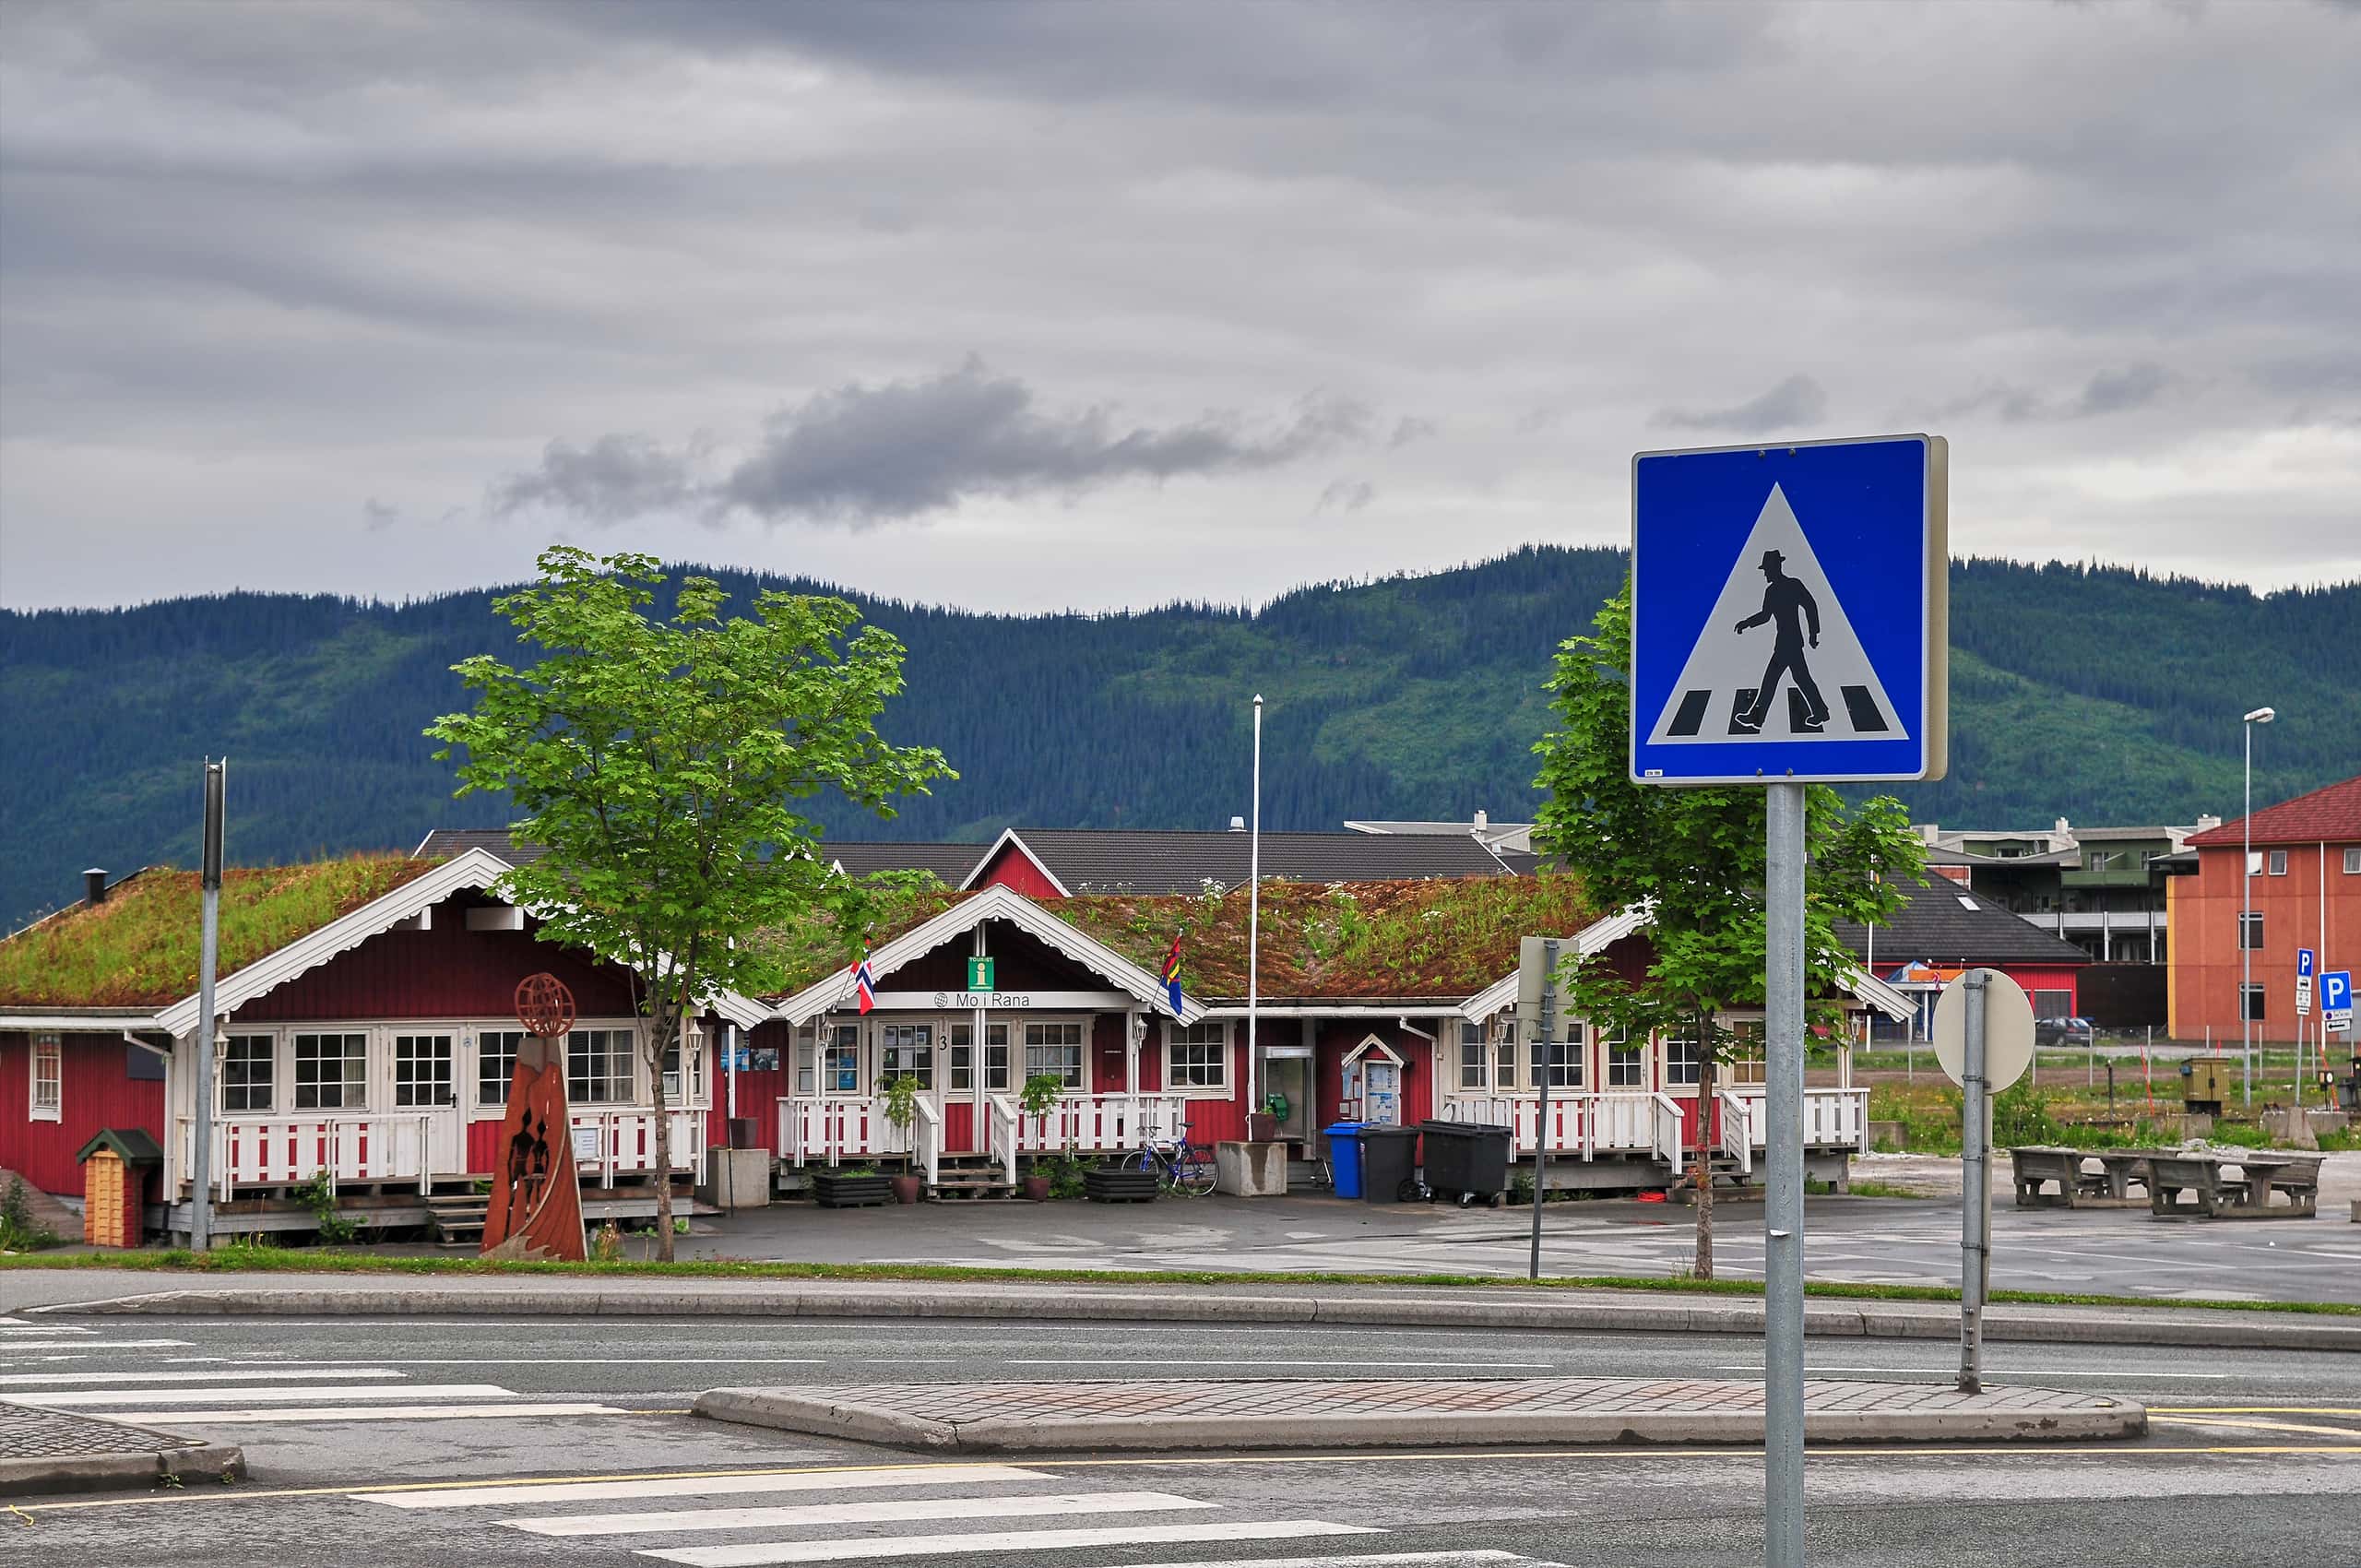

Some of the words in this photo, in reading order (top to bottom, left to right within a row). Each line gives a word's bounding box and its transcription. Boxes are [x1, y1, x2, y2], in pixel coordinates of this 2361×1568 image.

[2301, 953, 2310, 974] P
[956, 993, 979, 1007] Mo
[991, 993, 1029, 1007] Rana
[2328, 978, 2344, 1006] P
[939, 1036, 947, 1051] 3
